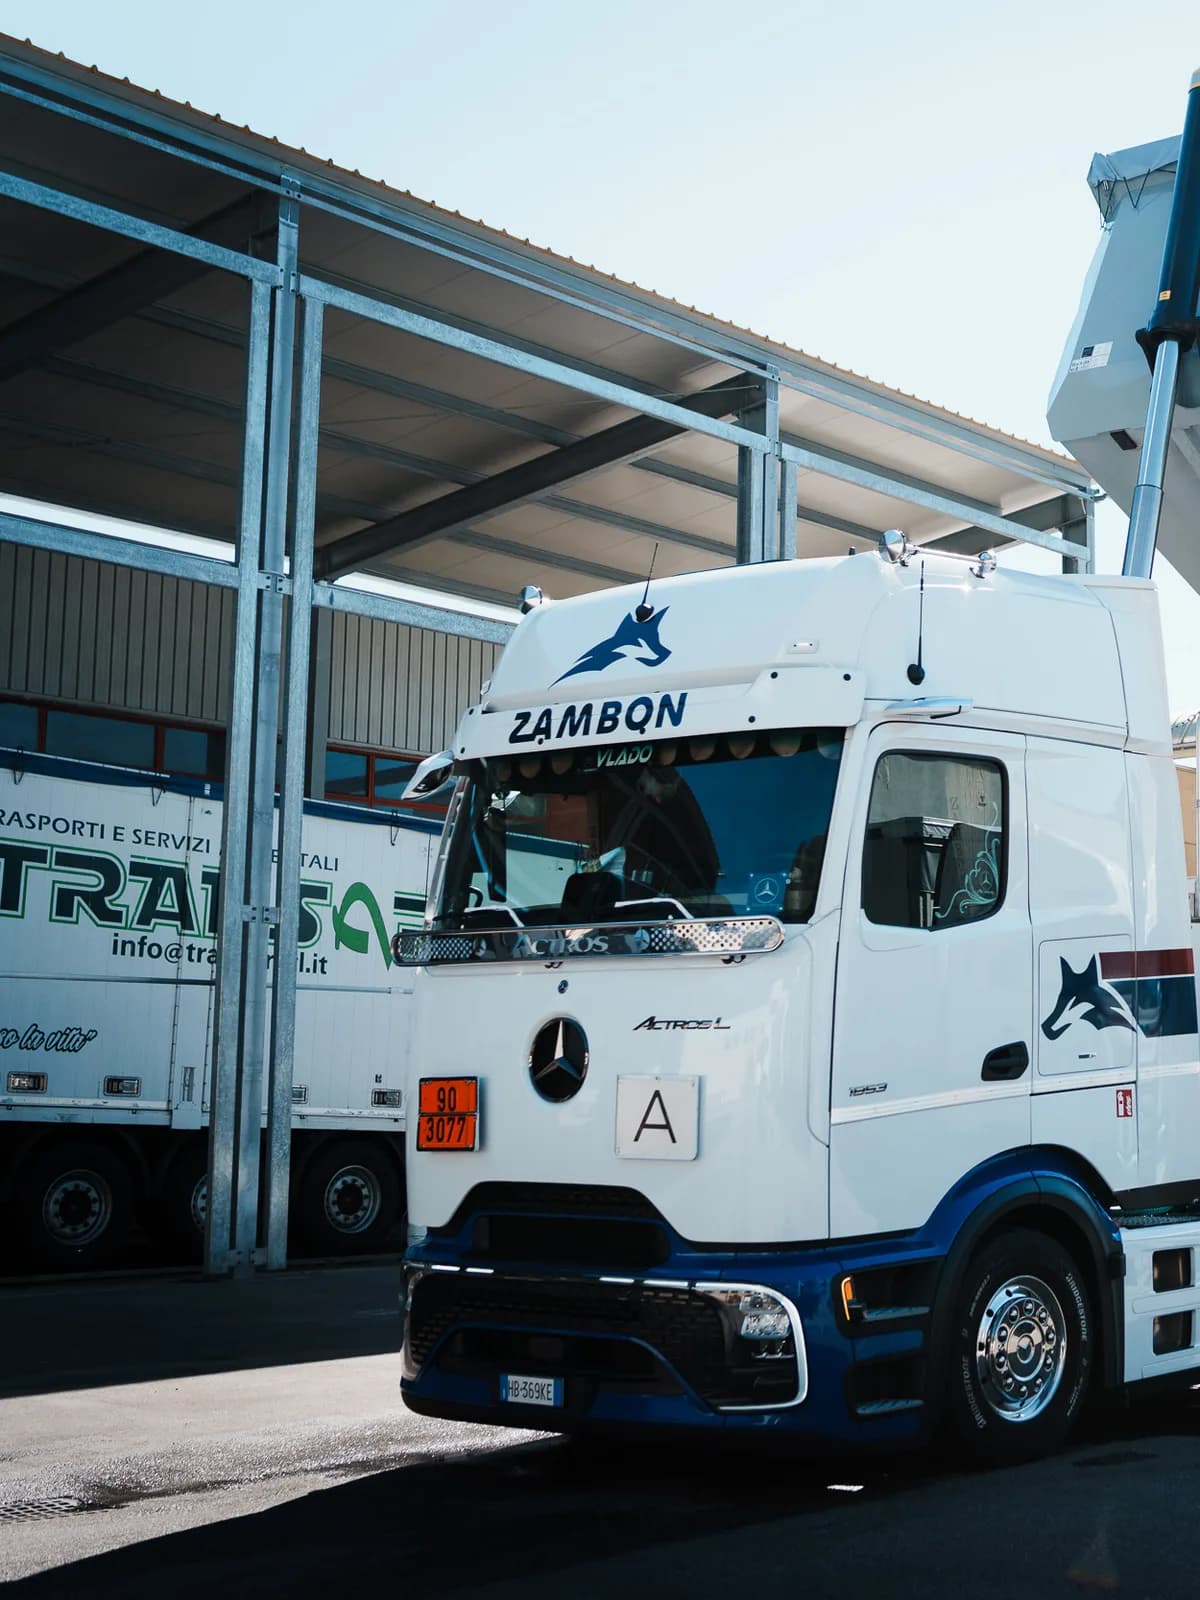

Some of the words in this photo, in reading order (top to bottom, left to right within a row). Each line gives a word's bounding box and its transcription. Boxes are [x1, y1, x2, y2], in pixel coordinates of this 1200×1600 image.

[509, 692, 688, 743] ZAMBON
[597, 745, 653, 768] VLADO
[113, 825, 125, 842] E
[132, 828, 211, 854] SERVIZI
[437, 1086, 457, 1112] 90
[426, 1116, 466, 1143] 3077
[633, 1089, 677, 1144] A
